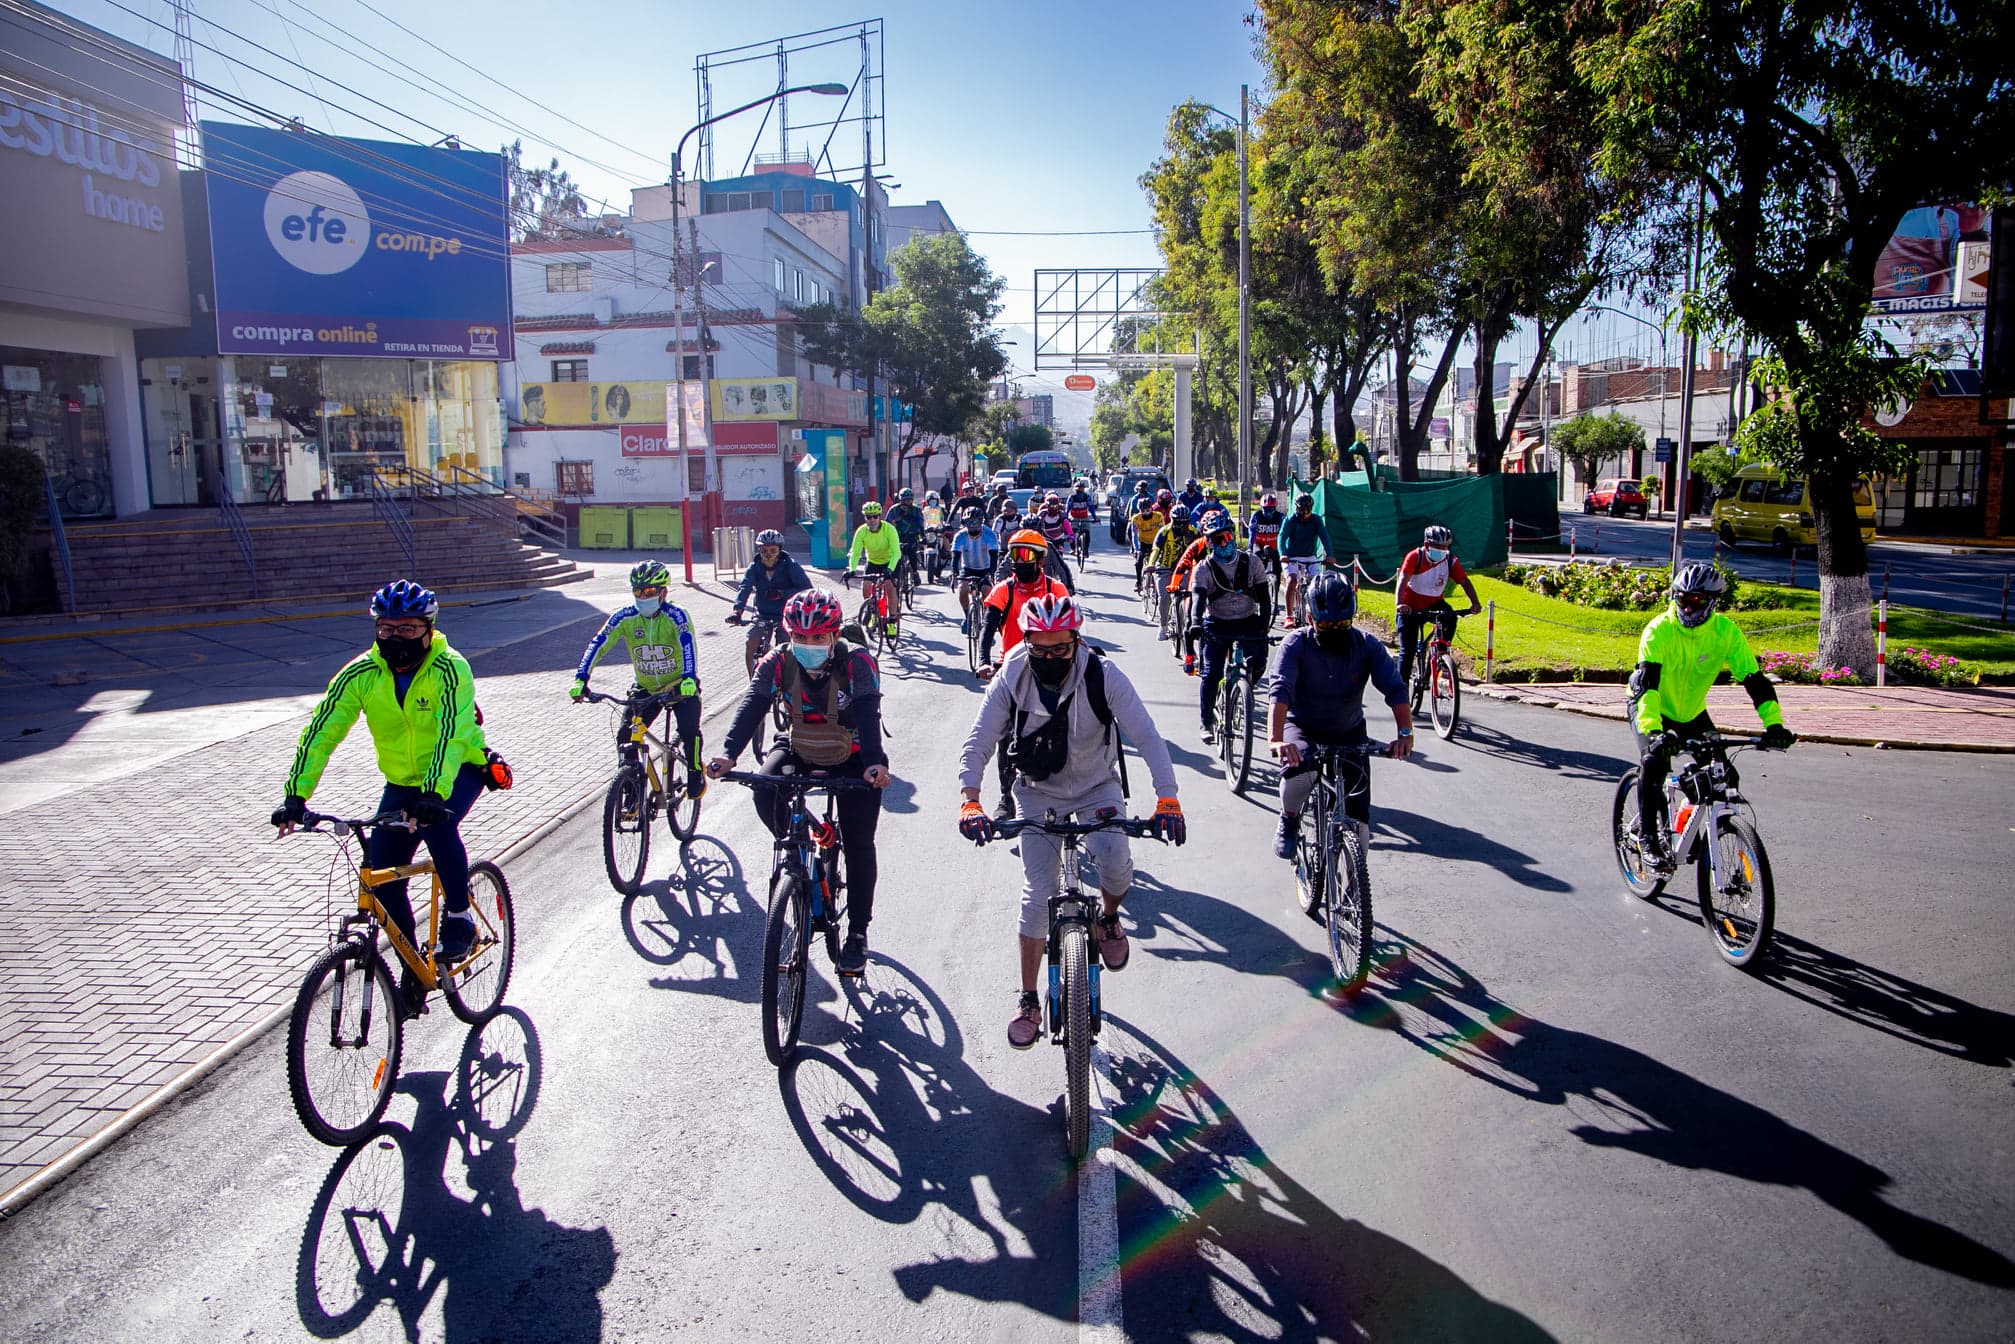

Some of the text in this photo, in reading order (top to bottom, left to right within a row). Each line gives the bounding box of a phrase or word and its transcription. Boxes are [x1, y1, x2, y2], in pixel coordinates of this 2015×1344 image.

[0, 89, 161, 188] estilos
[81, 174, 166, 232] home
[281, 206, 462, 260] efe com.pe
[232, 324, 378, 345] compra online
[384, 342, 464, 354] RETIRA EN TIENDA
[740, 442, 777, 450] AUTORIZADO
[635, 657, 678, 671] HYPER
